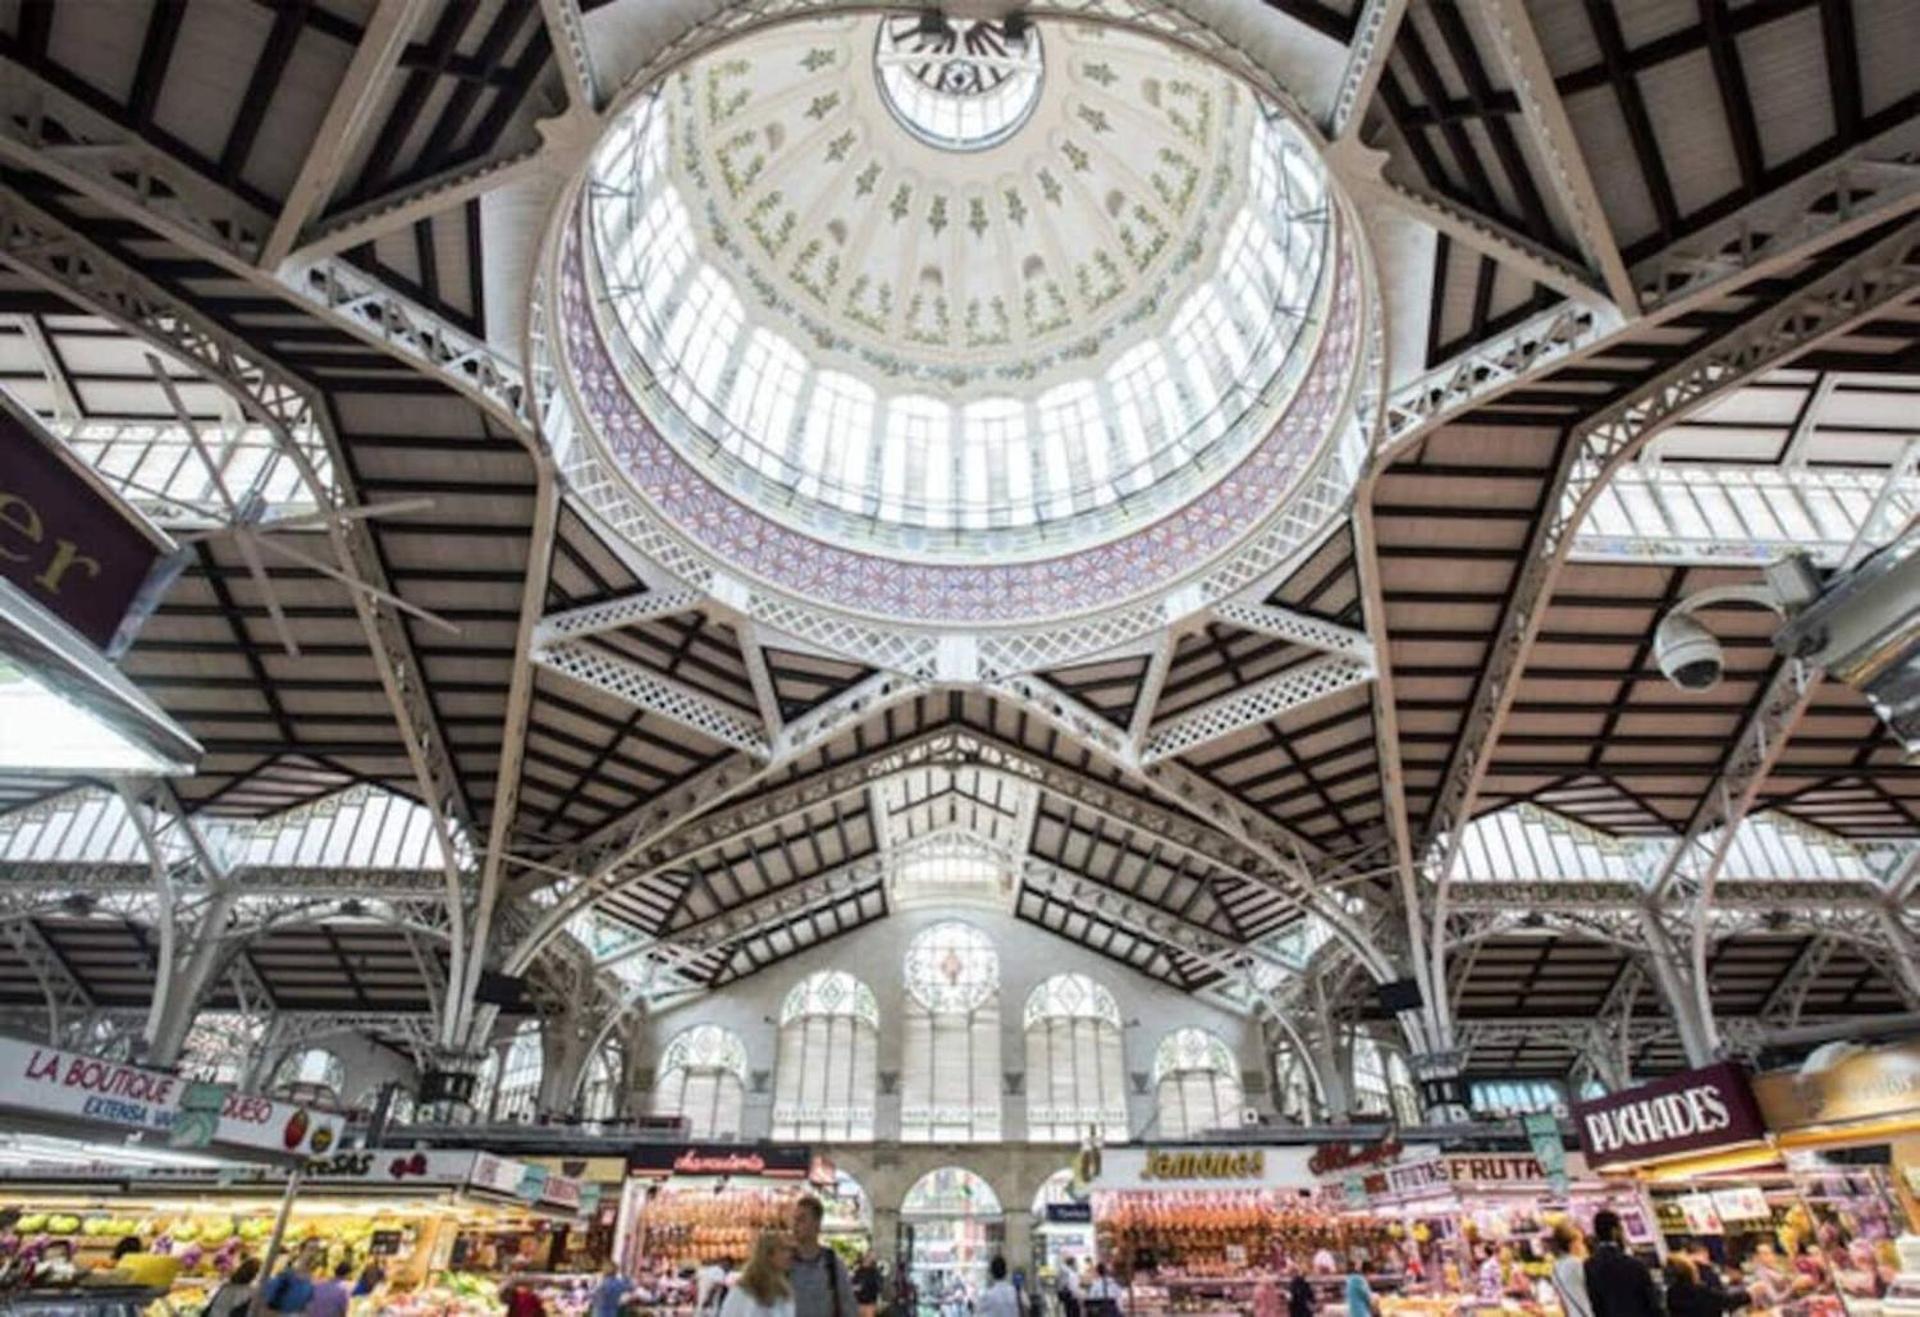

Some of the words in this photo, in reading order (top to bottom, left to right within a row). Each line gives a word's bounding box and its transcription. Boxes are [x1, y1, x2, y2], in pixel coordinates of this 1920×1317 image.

[25, 1051, 60, 1082] LA
[64, 1058, 174, 1104] BOUTIQUE
[1450, 1158, 1547, 1179] FRUTA
